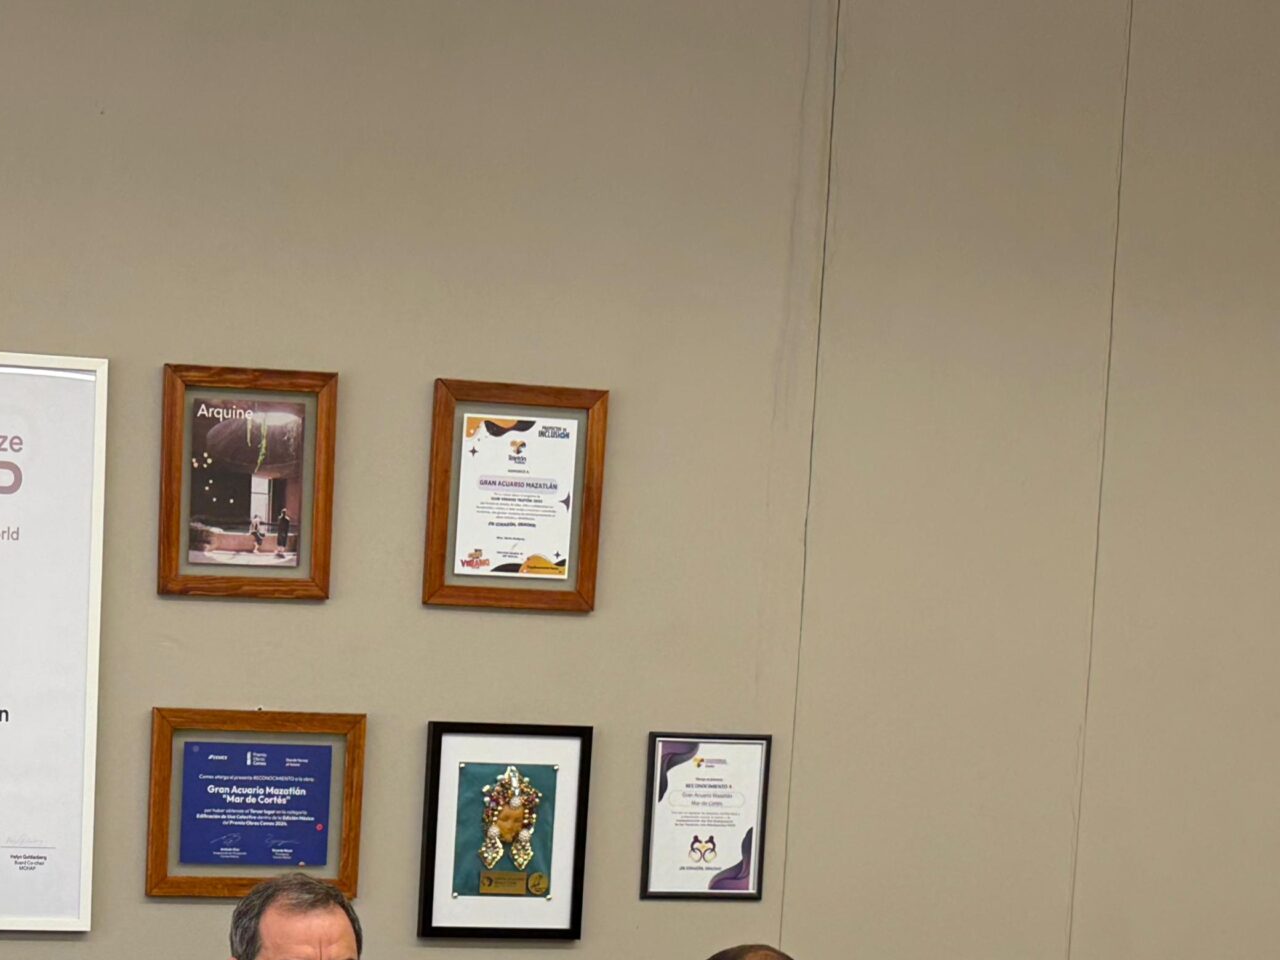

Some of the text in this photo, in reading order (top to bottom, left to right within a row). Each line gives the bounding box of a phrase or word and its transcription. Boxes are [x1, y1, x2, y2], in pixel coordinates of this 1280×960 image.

[197, 404, 253, 422] Arquine
[498, 480, 524, 488] ACUARIO
[526, 482, 558, 490] MAZATLÁN
[207, 785, 306, 796] Gran Acuario Mazatlán
[223, 795, 291, 804] "Mar de Cortés"
